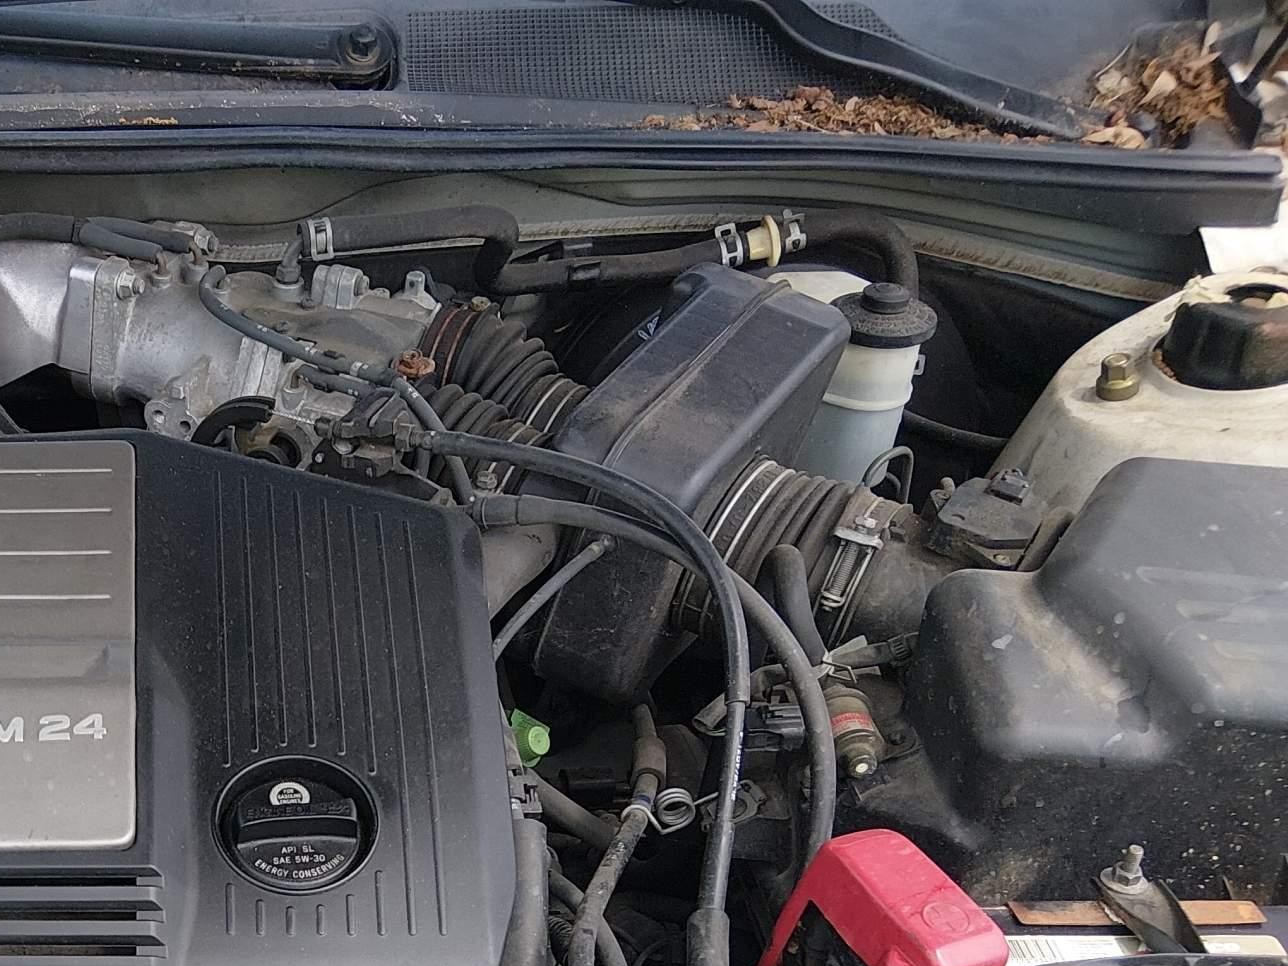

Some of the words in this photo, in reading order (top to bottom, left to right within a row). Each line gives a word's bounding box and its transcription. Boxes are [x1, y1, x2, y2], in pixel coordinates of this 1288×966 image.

[39, 713, 107, 741] 24
[281, 846, 297, 855] API
[302, 845, 315, 853] SL
[254, 859, 289, 878] ENERGY
[292, 854, 346, 879] CONSERVING
[273, 857, 291, 865] SAE
[295, 854, 326, 863] 5W-30
